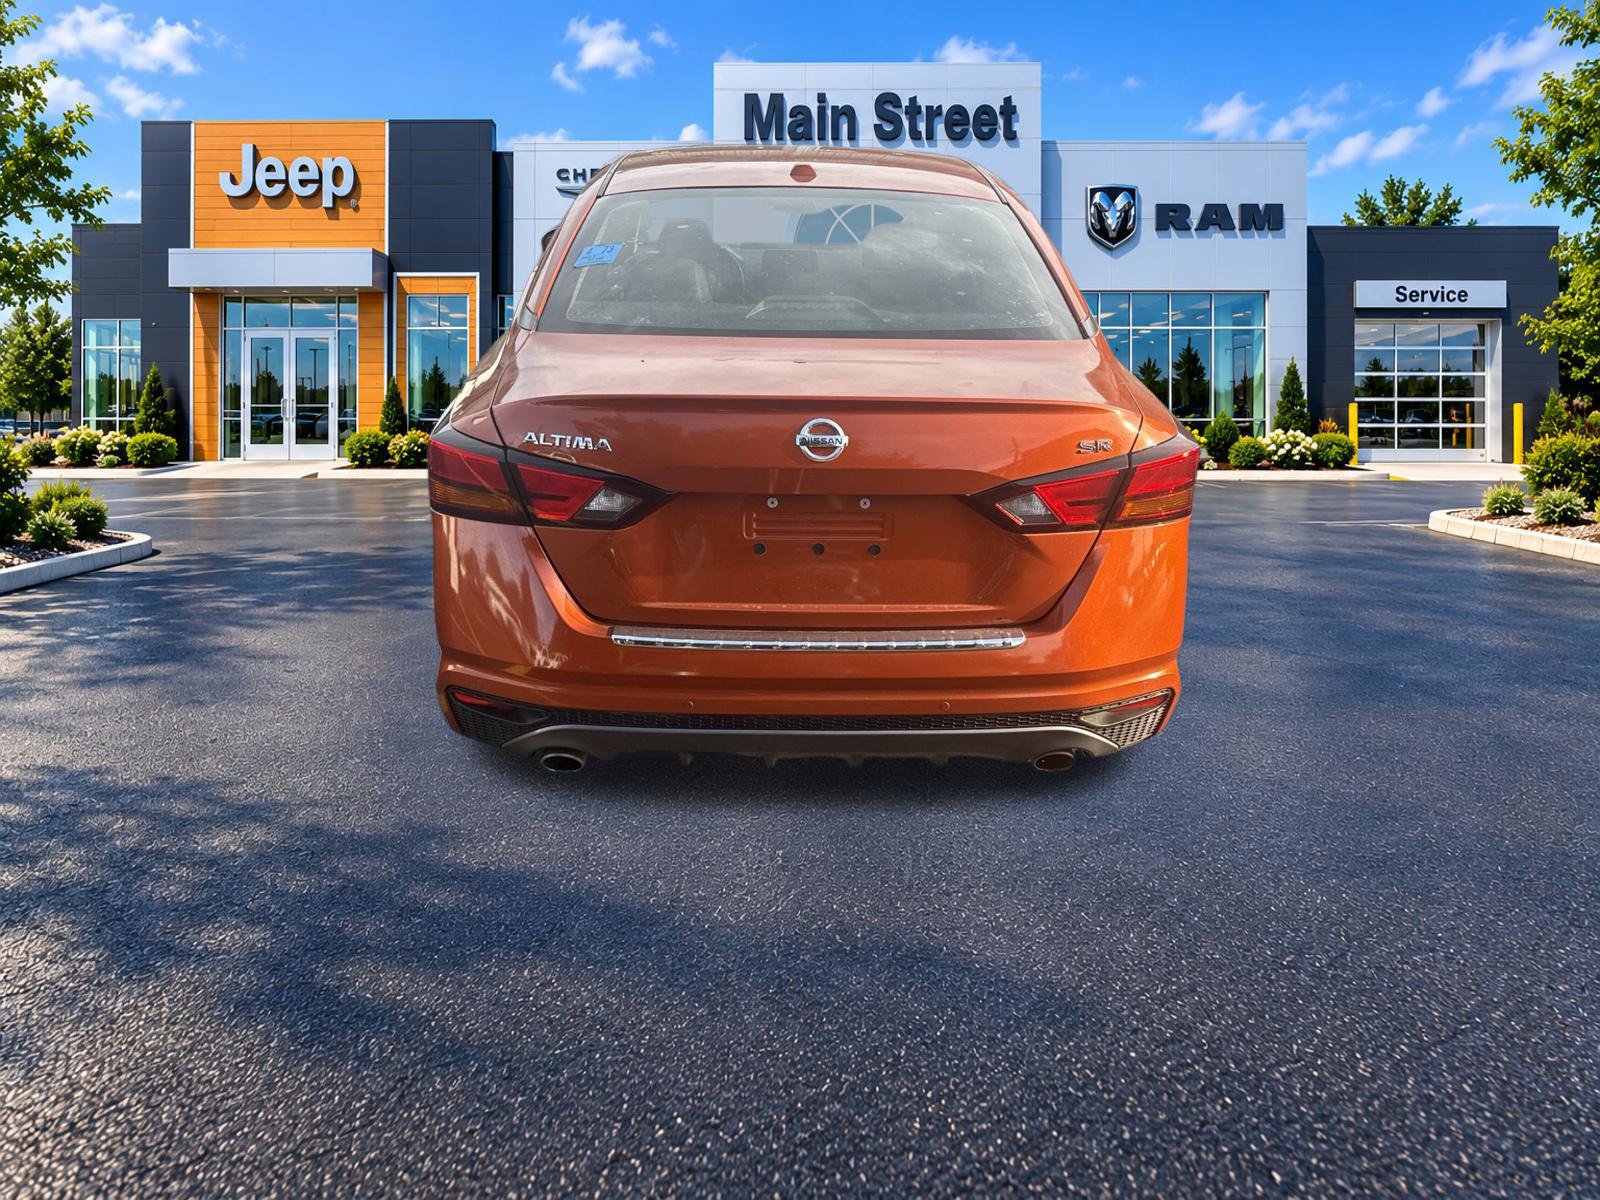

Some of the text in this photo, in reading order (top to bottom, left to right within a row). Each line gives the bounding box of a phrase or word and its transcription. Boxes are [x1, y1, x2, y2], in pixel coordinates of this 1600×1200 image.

[744, 91, 1017, 141] Main Street
[218, 143, 354, 208] Jeep
[1155, 203, 1284, 231] RAM
[1395, 285, 1469, 303] Service
[522, 431, 612, 452] ALTIMA
[800, 437, 843, 446] NISSAN
[1076, 439, 1113, 454] SR
